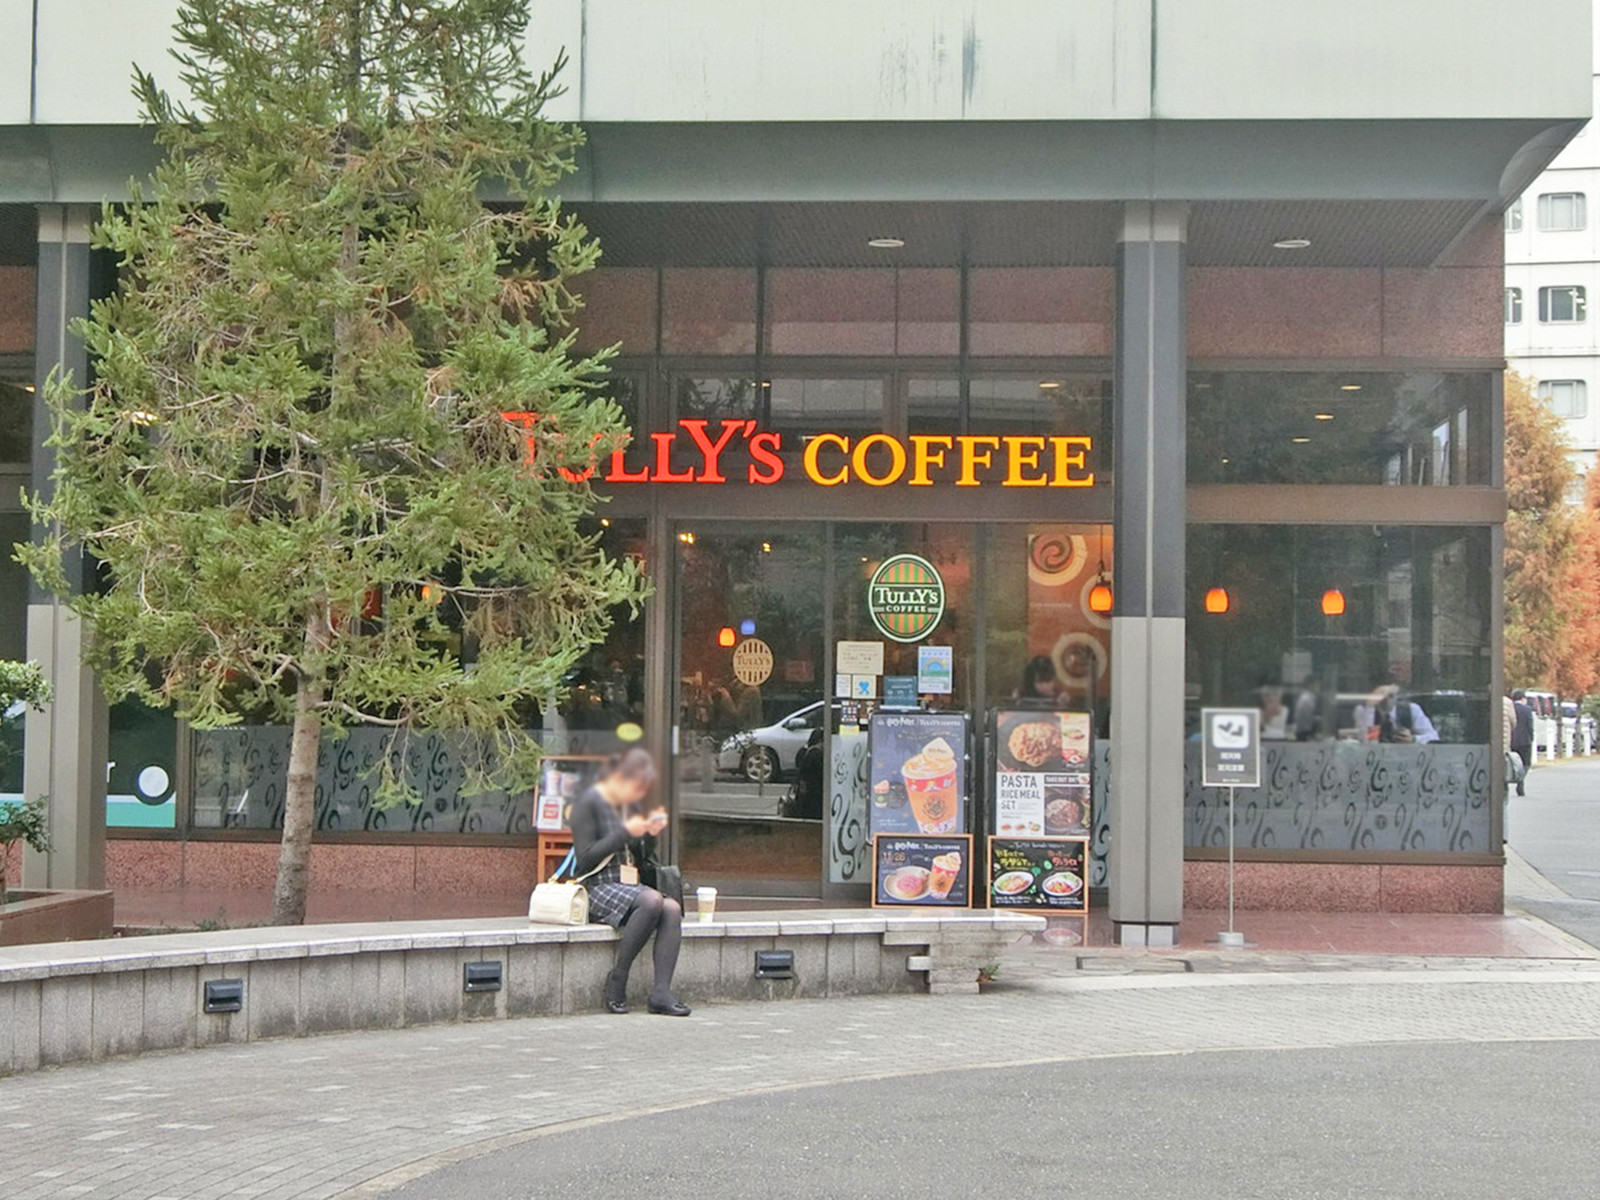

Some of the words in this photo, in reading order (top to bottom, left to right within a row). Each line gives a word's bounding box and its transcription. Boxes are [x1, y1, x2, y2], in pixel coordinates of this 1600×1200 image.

[803, 432, 1095, 487] COFFEE
[874, 587, 938, 604] TULLY'S
[885, 605, 927, 613] COFFEE
[735, 655, 770, 665] TULLY'S
[1001, 775, 1037, 788] PASTA
[1001, 789, 1018, 799] RICE
[1020, 789, 1041, 799] MEAL
[1001, 800, 1016, 810] SET
